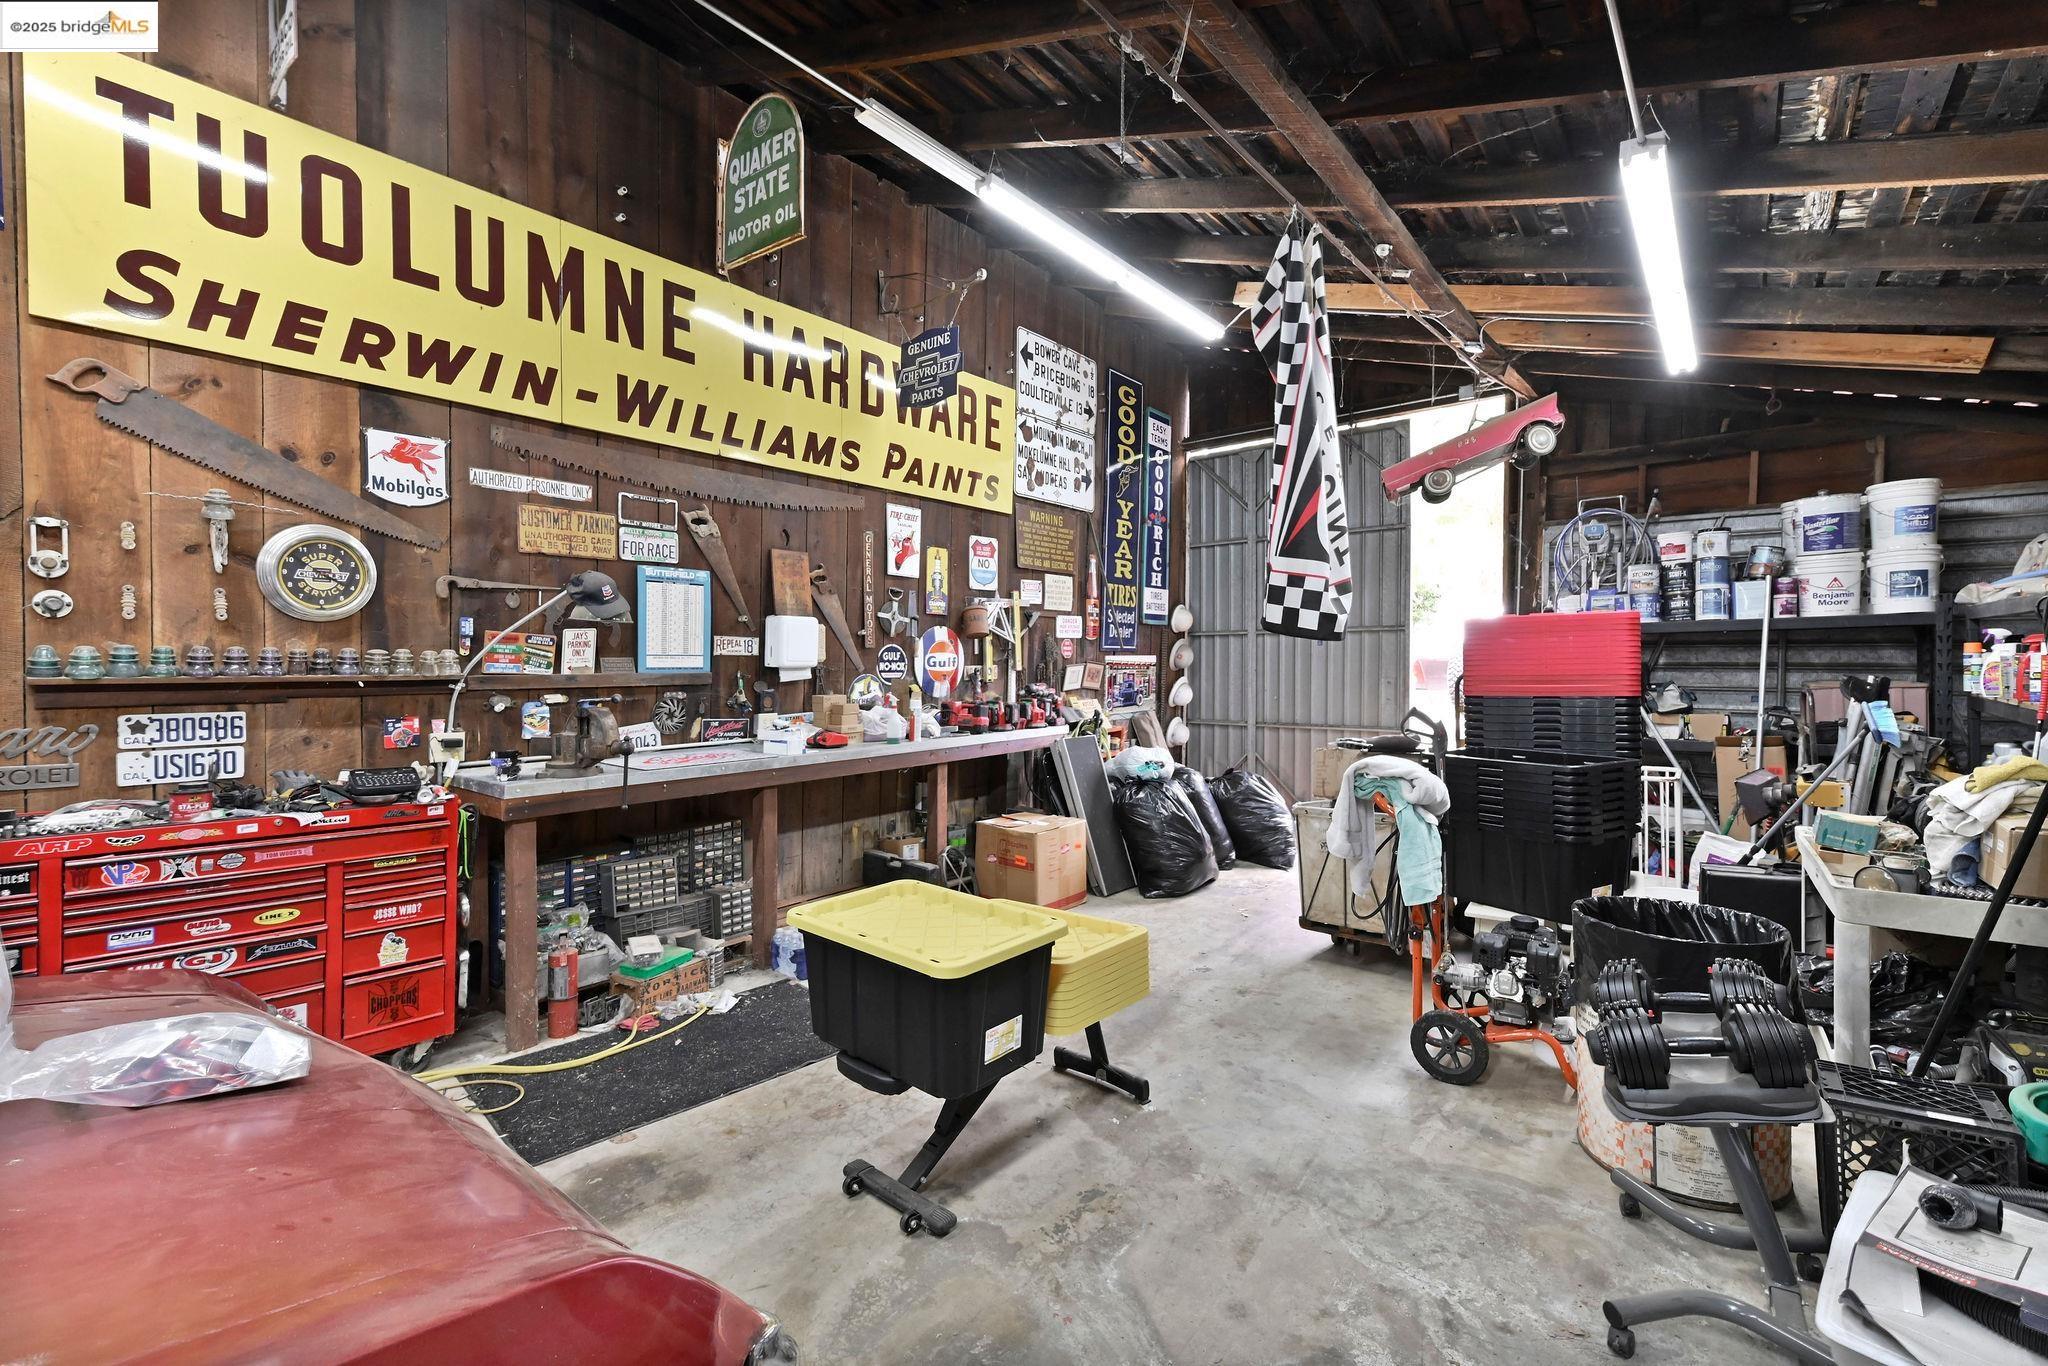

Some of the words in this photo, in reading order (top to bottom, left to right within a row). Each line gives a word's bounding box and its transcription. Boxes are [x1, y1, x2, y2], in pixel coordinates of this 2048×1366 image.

[729, 127, 797, 186] QUAKER
[734, 163, 790, 214] STATE
[95, 76, 696, 365] TUOLUMNE
[728, 214, 771, 246] MOTOR
[775, 202, 797, 225] OIL
[907, 331, 951, 356] GENUINE
[1034, 342, 1060, 365] BOWER
[1063, 355, 1080, 374] CAVE
[902, 360, 954, 383] CHEVROLET
[1034, 362, 1081, 393] BRICEBURG
[1088, 385, 1095, 398] 18
[912, 386, 944, 404] PARTS
[1020, 380, 1073, 412] COULTERVILLE
[1076, 401, 1083, 415] 13
[1034, 425, 1063, 448] MOUNTIN
[1152, 422, 1167, 436] EASY
[1151, 432, 1168, 447] TERMS
[882, 442, 1001, 503] PAINTS
[371, 475, 444, 500] Mobilgas
[472, 470, 522, 490] AUTHORIZED
[526, 477, 569, 497] PERSONNEL
[572, 486, 591, 499] ONLY
[520, 507, 572, 529] CUSTOMER
[577, 515, 615, 535] PARKING
[1030, 510, 1063, 527] WARNING
[524, 531, 586, 544] UNAUTHORIZED
[591, 537, 612, 546] CARS
[525, 540, 545, 549] WILL
[548, 542, 558, 550] BE
[561, 543, 589, 552] TOWED
[622, 540, 645, 557] FOR
[647, 542, 675, 559] RACE
[301, 552, 343, 566] SUPER
[865, 534, 873, 592] GENERAL
[977, 559, 990, 569] NO
[646, 568, 695, 578] BUTTERFIELD
[298, 581, 345, 597] SERVICE
[1107, 583, 1136, 607] TIRES
[1812, 591, 1855, 602] Benjamin
[865, 596, 874, 645] MOTORS
[1108, 609, 1135, 624] Slected
[567, 641, 591, 649] PARKING
[715, 638, 742, 651] REPEAL
[743, 639, 754, 653] 18
[882, 651, 901, 661] GULF
[926, 656, 957, 668] Gulf
[879, 661, 906, 671] NO-NOX
[150, 715, 244, 743] 380986
[123, 737, 148, 745] CAL
[123, 772, 148, 781] CAL
[15, 838, 92, 856] ARP
[107, 836, 144, 844] UFO
[101, 861, 136, 885] VP
[110, 930, 151, 941] DYNA
[371, 987, 417, 1014] CHOPPERS
[1877, 1245, 1973, 1285] UNIVERSAL
